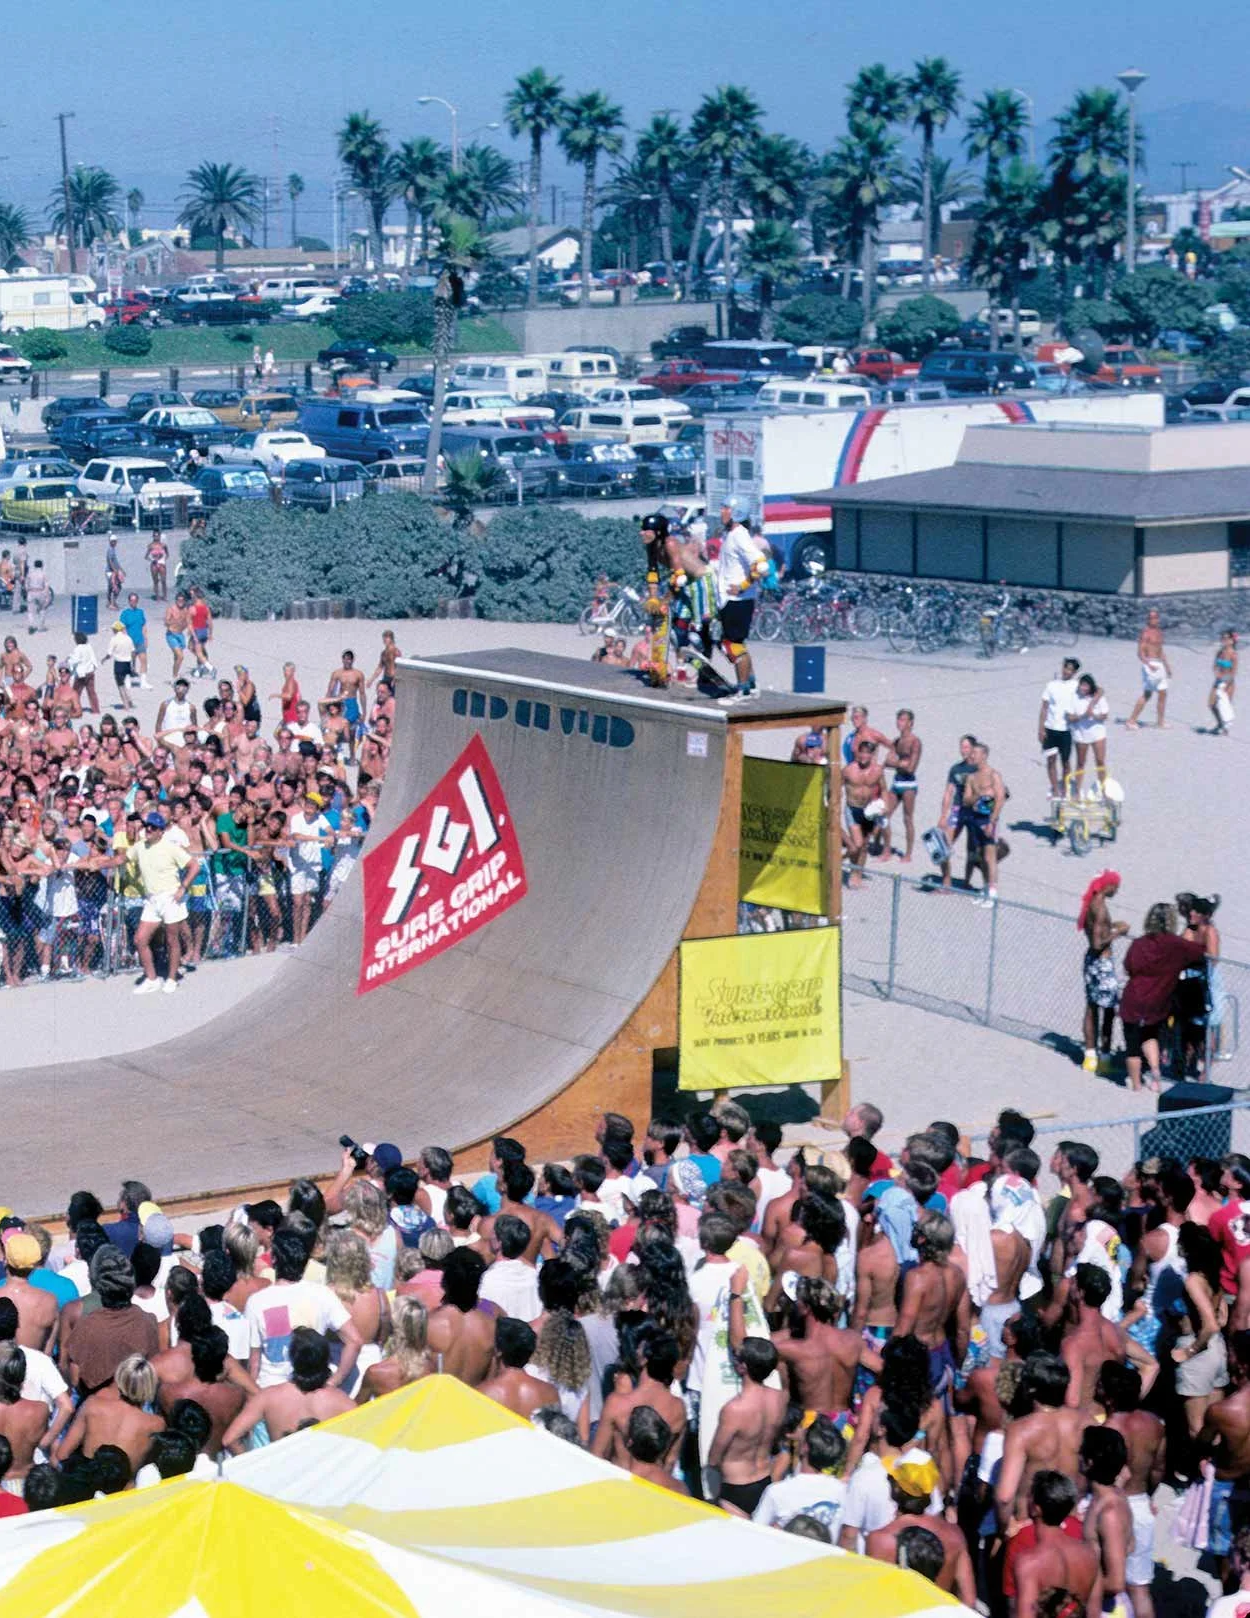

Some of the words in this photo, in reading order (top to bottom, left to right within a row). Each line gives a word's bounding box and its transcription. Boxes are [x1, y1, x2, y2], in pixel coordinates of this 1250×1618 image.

[366, 871, 522, 980] INTERNATIONAL
[374, 899, 445, 959] SURE
[450, 851, 507, 909] GRIP
[757, 1030, 781, 1044] YEARS
